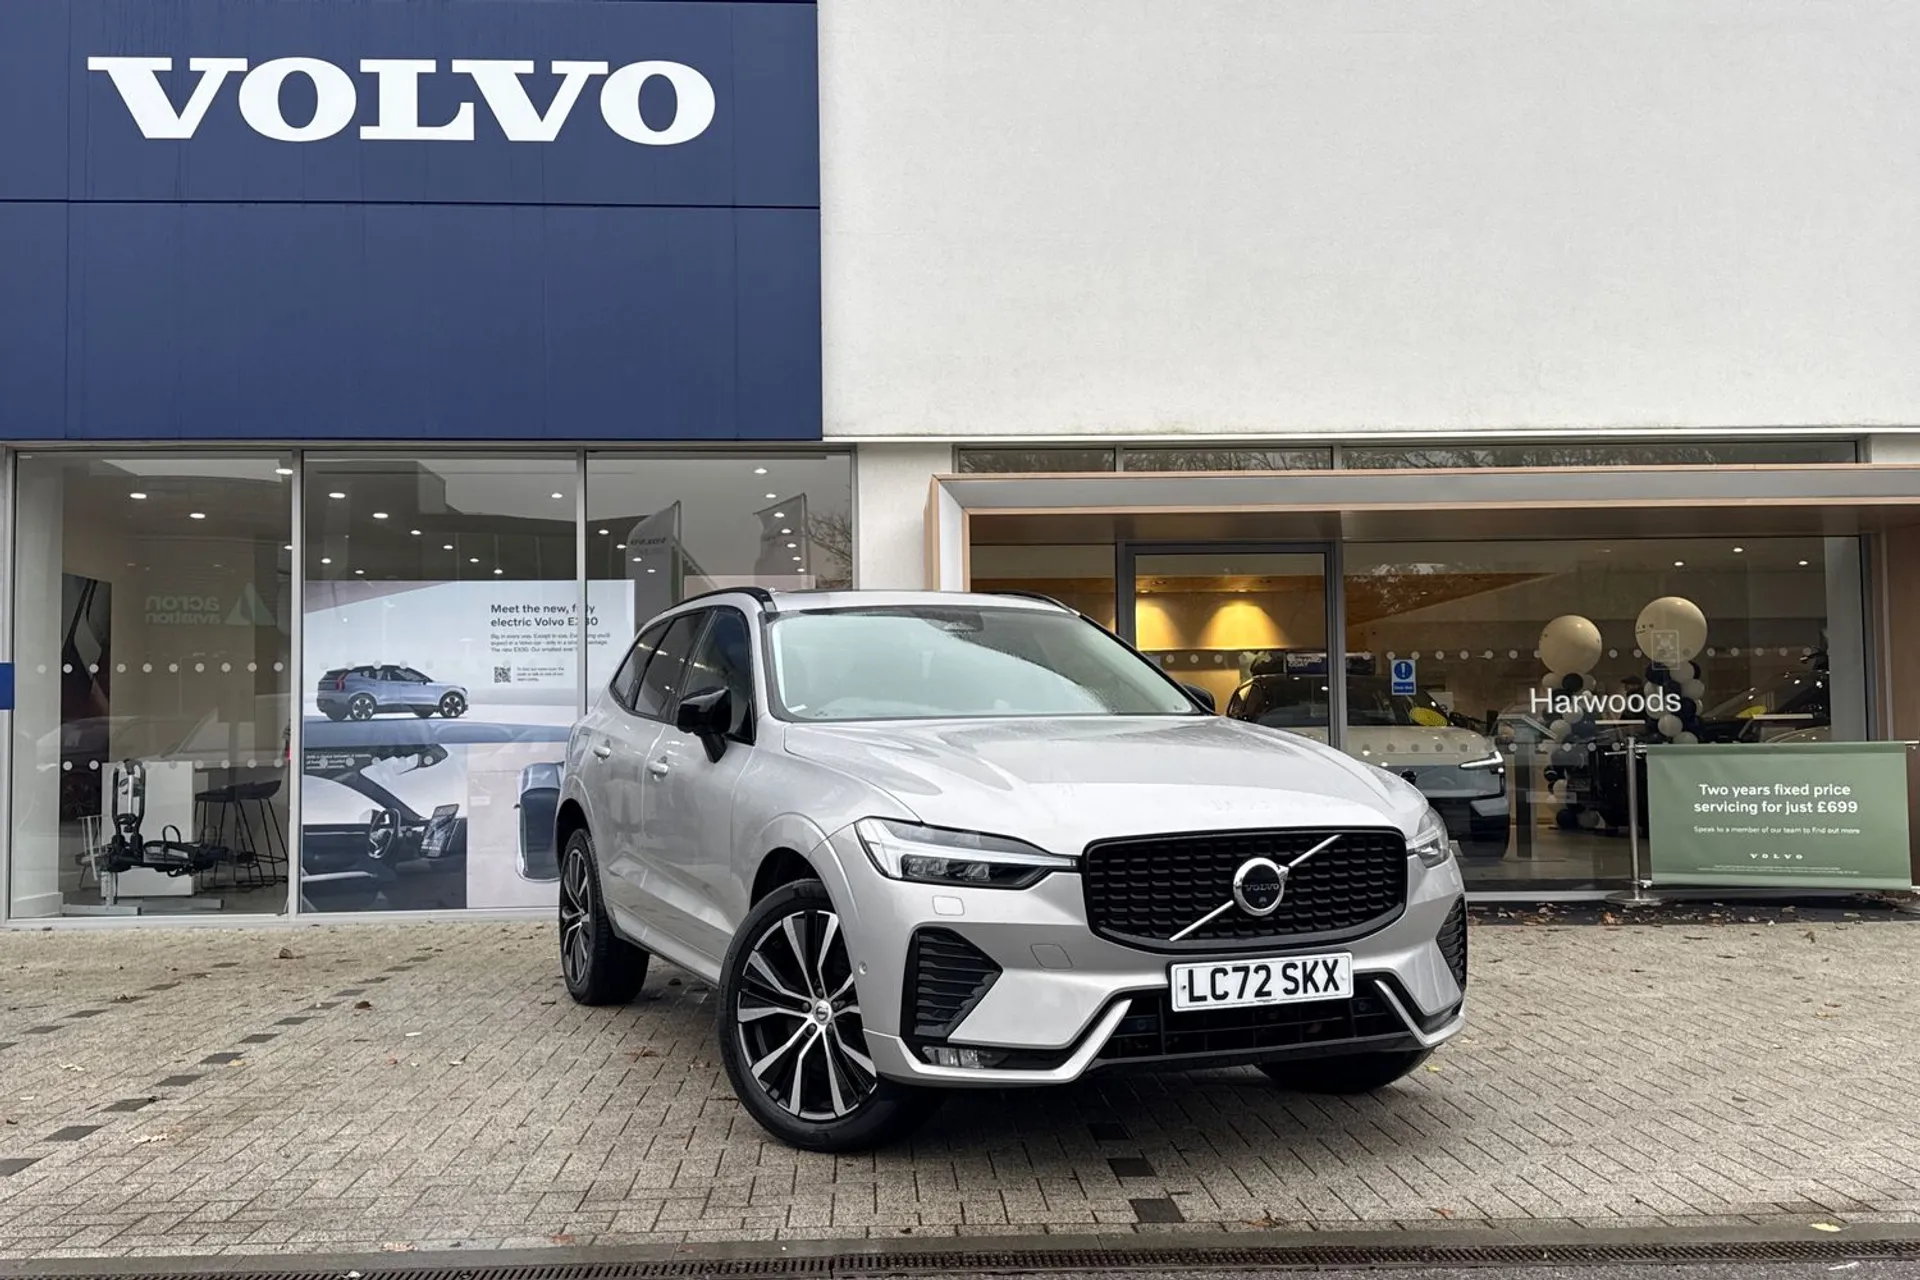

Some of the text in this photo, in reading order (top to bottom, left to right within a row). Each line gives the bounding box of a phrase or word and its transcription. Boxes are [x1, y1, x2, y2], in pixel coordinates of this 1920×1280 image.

[88, 56, 715, 145] VOLVO
[490, 604, 520, 613] Meet
[522, 604, 541, 613] the
[543, 605, 570, 615] new,
[490, 617, 532, 627] electric
[534, 617, 565, 626] Volvo
[1529, 686, 1682, 714] Harwoods
[1698, 783, 1851, 798] Two years fixed price
[1693, 801, 1858, 815] servicing for just £699
[1694, 825, 1715, 833] Speak
[1783, 826, 1801, 834] team
[1803, 826, 1811, 834] to
[1812, 826, 1826, 834] find
[1244, 882, 1280, 892] VOLVO
[1187, 958, 1340, 1003] LC72 SKX
